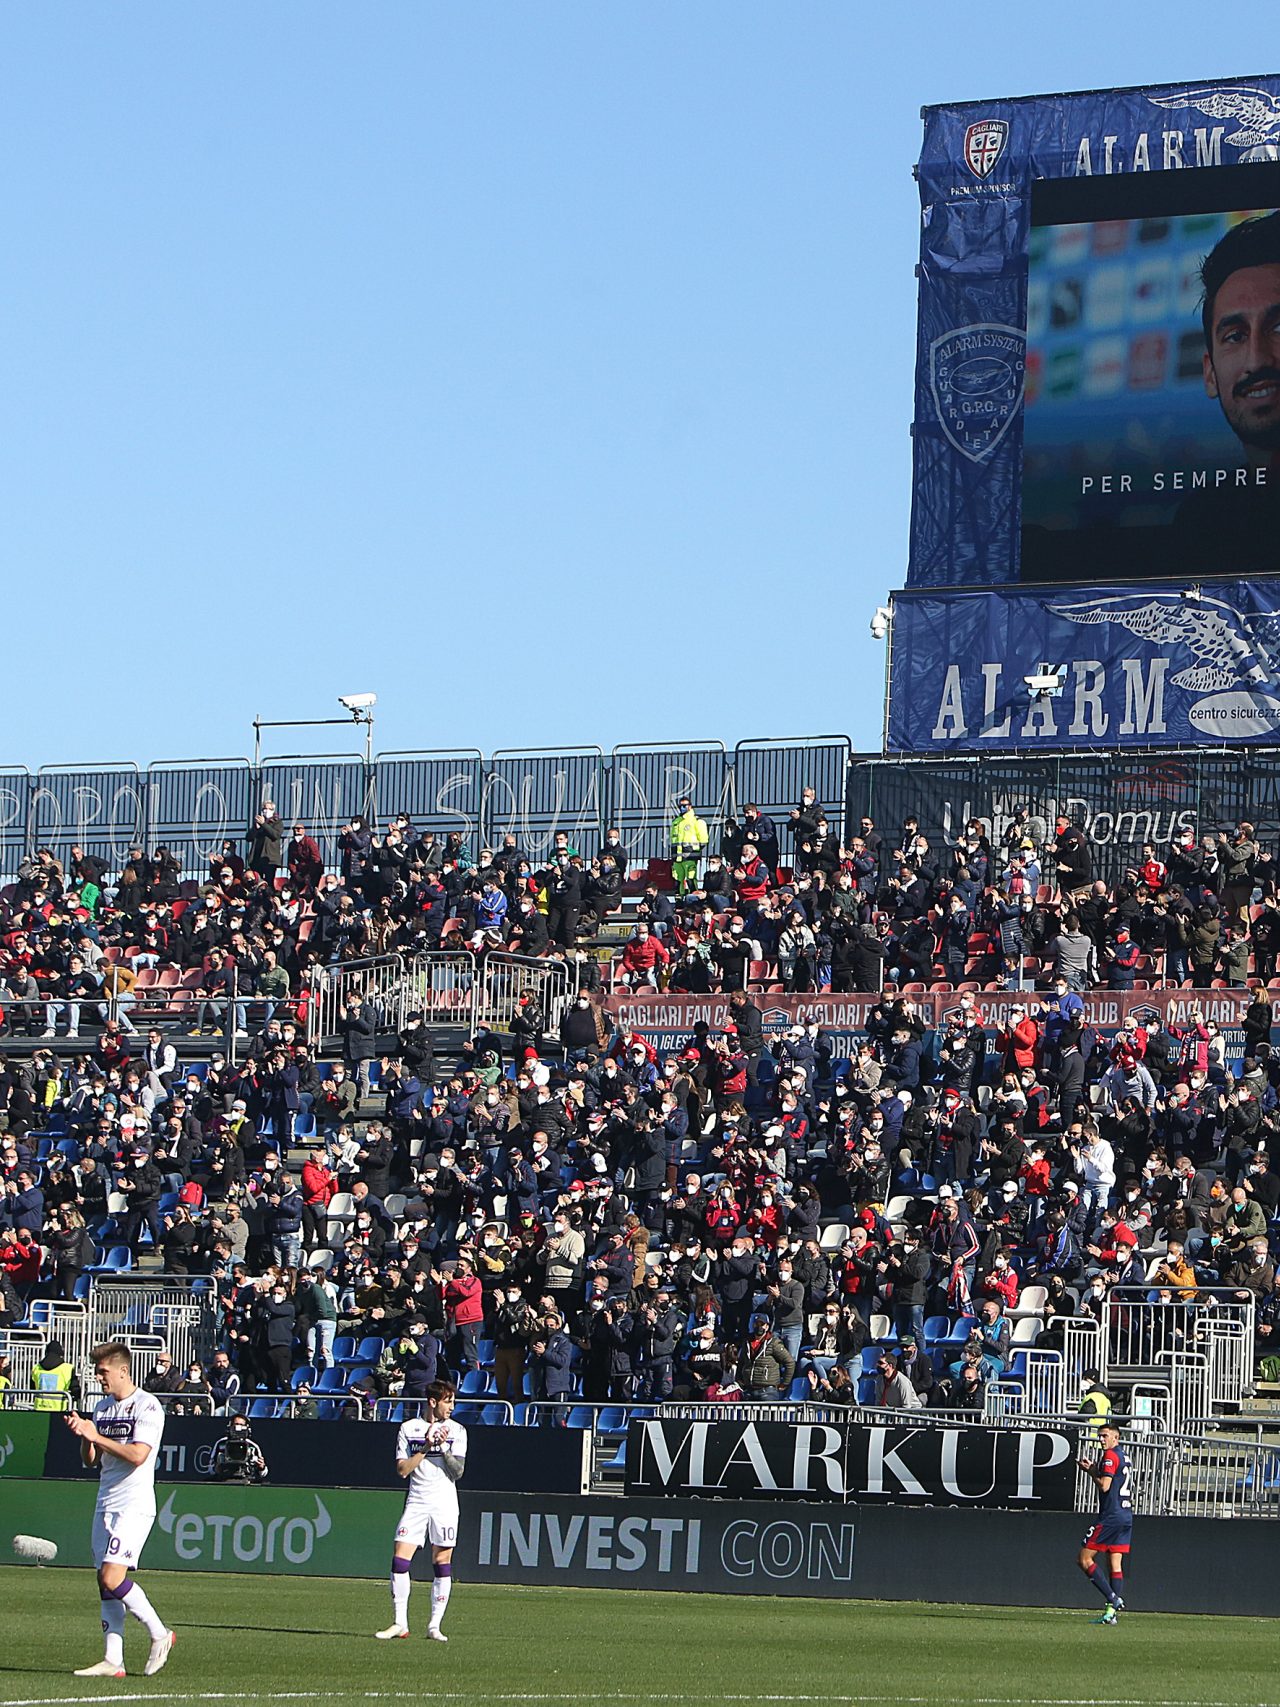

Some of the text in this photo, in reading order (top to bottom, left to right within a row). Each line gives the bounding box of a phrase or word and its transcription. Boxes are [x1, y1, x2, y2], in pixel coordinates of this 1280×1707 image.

[971, 123, 1005, 136] CAGLIARI
[1074, 126, 1226, 177] ALARM
[940, 334, 1025, 362] ALARM SYSTEM
[962, 400, 998, 415] G.P.G.
[1082, 475, 1133, 495] PER
[1153, 467, 1267, 491] SEMPRE
[931, 656, 1171, 741] ALARM
[1190, 708, 1229, 721] centro
[436, 765, 744, 854] SQUADRA
[617, 1004, 682, 1027] CAGLIARI
[684, 1004, 711, 1027] FAN
[630, 1420, 1072, 1500] MARKUP
[441, 1526, 455, 1541] 10
[477, 1511, 854, 1581] INVESTI CON
